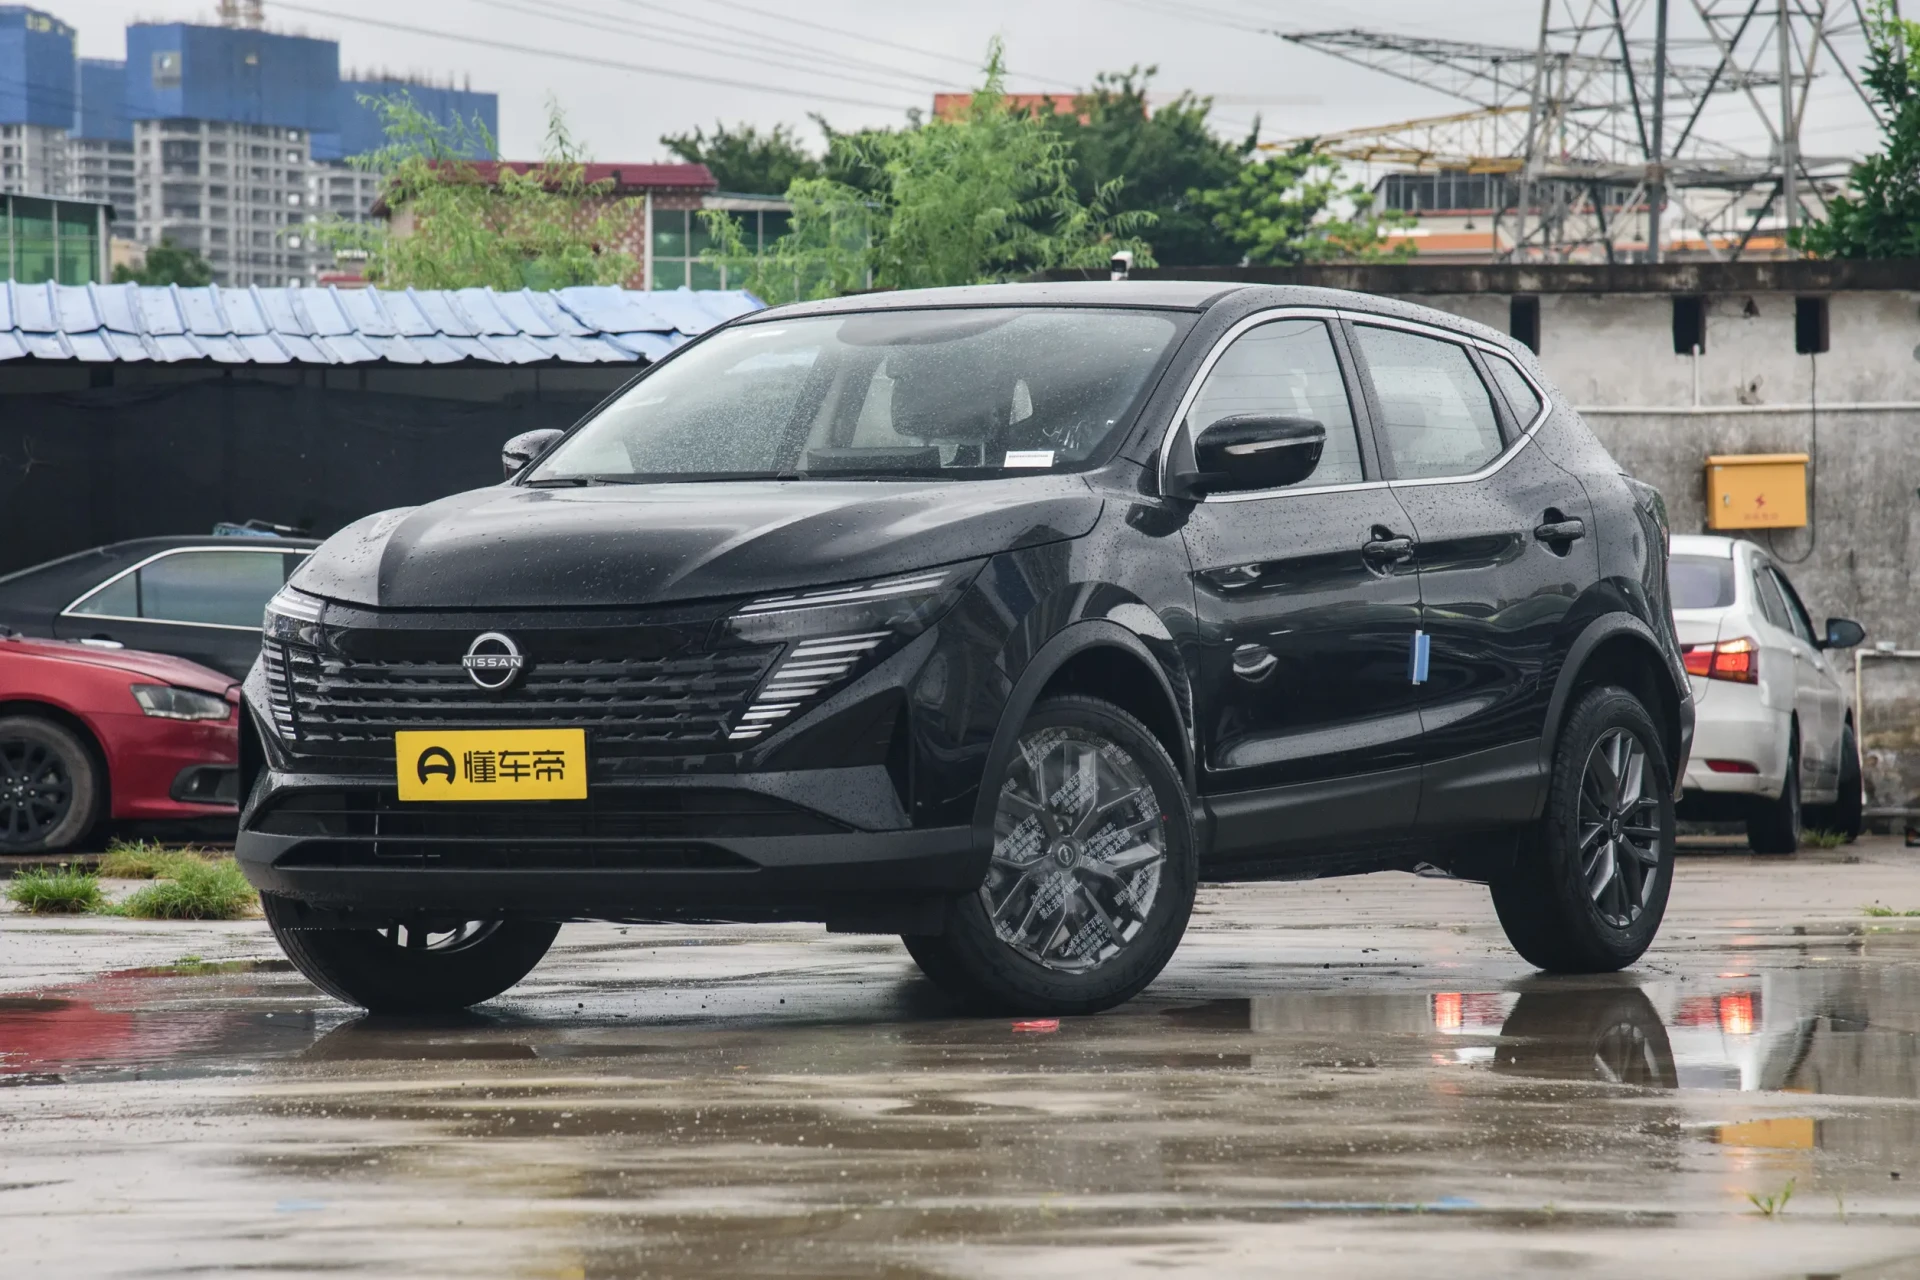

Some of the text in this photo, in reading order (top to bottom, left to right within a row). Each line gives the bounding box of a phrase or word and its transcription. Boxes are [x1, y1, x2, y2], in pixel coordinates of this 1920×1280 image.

[463, 658, 522, 667] NISSAN
[463, 750, 565, 783] 懂车帝
